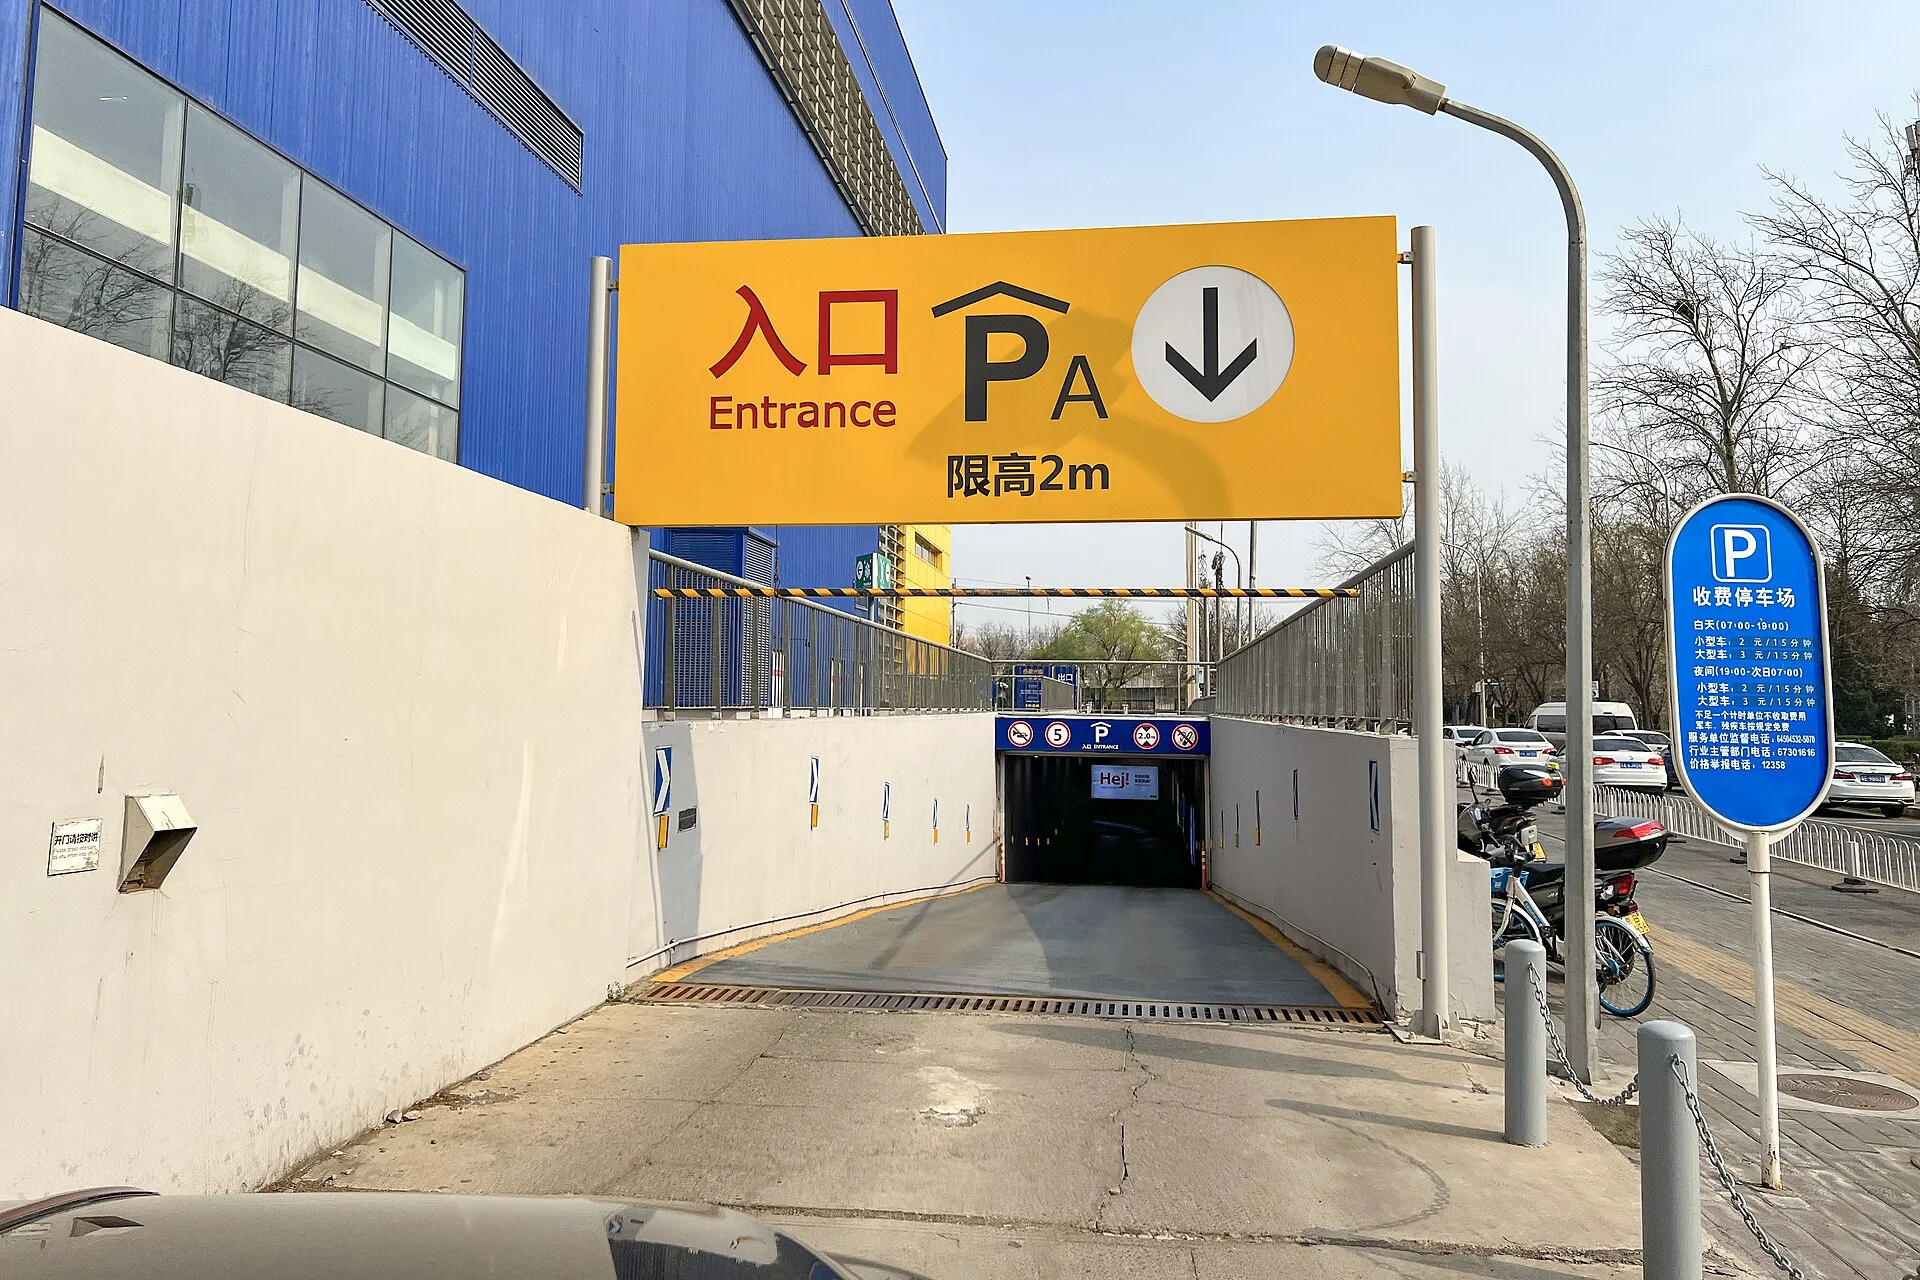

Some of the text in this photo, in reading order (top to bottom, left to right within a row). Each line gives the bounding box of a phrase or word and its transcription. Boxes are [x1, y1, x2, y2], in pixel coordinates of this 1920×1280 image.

[708, 285, 898, 378] 入口
[709, 397, 897, 430] Entrance
[946, 452, 1111, 499] 限高2m
[1723, 529, 1757, 578] P
[1693, 586, 1796, 608] 收费停车场
[1057, 673, 1073, 682] 出口
[1695, 710, 1807, 722] 不足一个计时单位不收取费用
[1053, 728, 1062, 742] 5
[1095, 726, 1109, 743] P
[1100, 772, 1129, 788] Hej!
[54, 832, 99, 846] 开门请按对讲
